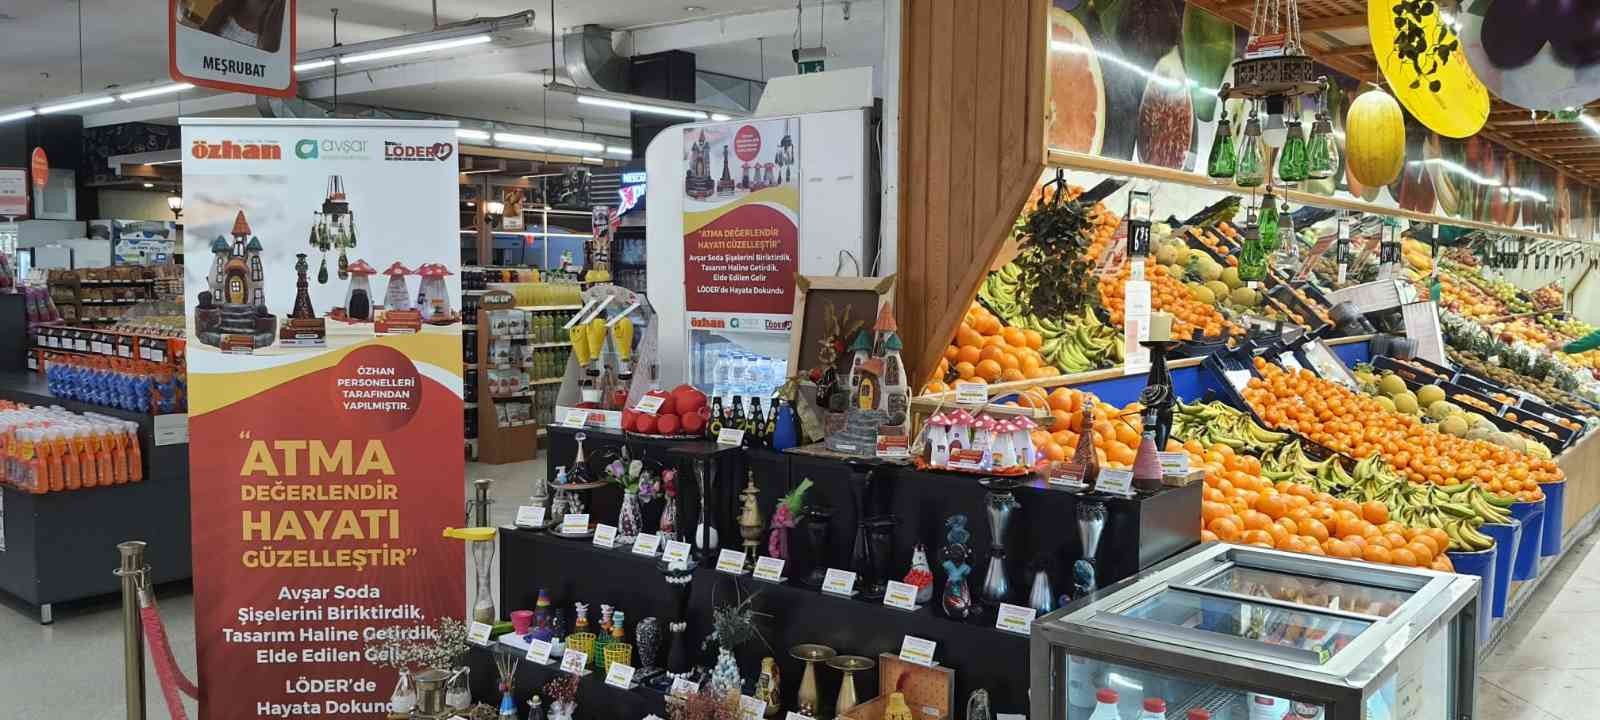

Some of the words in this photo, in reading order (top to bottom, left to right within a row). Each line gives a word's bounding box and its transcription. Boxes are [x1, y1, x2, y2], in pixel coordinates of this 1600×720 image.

[203, 55, 266, 78] MEŞRUBAT
[191, 139, 281, 160] özhan
[321, 139, 368, 153] avşar
[724, 226, 779, 238] DEĞERLENDİR
[698, 241, 725, 249] HAYATI
[728, 264, 748, 272] Haline
[751, 274, 767, 282] Gelir
[729, 286, 753, 295] Hayata
[754, 286, 784, 295] Dokundu
[357, 364, 395, 376] ÖZHAN
[337, 377, 415, 388] PERSONELLERİ
[342, 390, 410, 399] TARAFINDAN
[343, 401, 410, 412] YAPILMIŞTIR.
[240, 479, 398, 501] DEĞERLENDİR
[242, 509, 400, 541] HAYATI
[278, 586, 330, 603] Avşar
[334, 584, 380, 600] Soda
[237, 606, 323, 625] Şişelerini
[327, 604, 425, 621] Biriktirdik,
[222, 628, 295, 643] Tasarım
[300, 626, 359, 642] Haline
[256, 649, 298, 664] Elde
[302, 648, 361, 663] Edilen
[256, 701, 321, 718] Hayata
